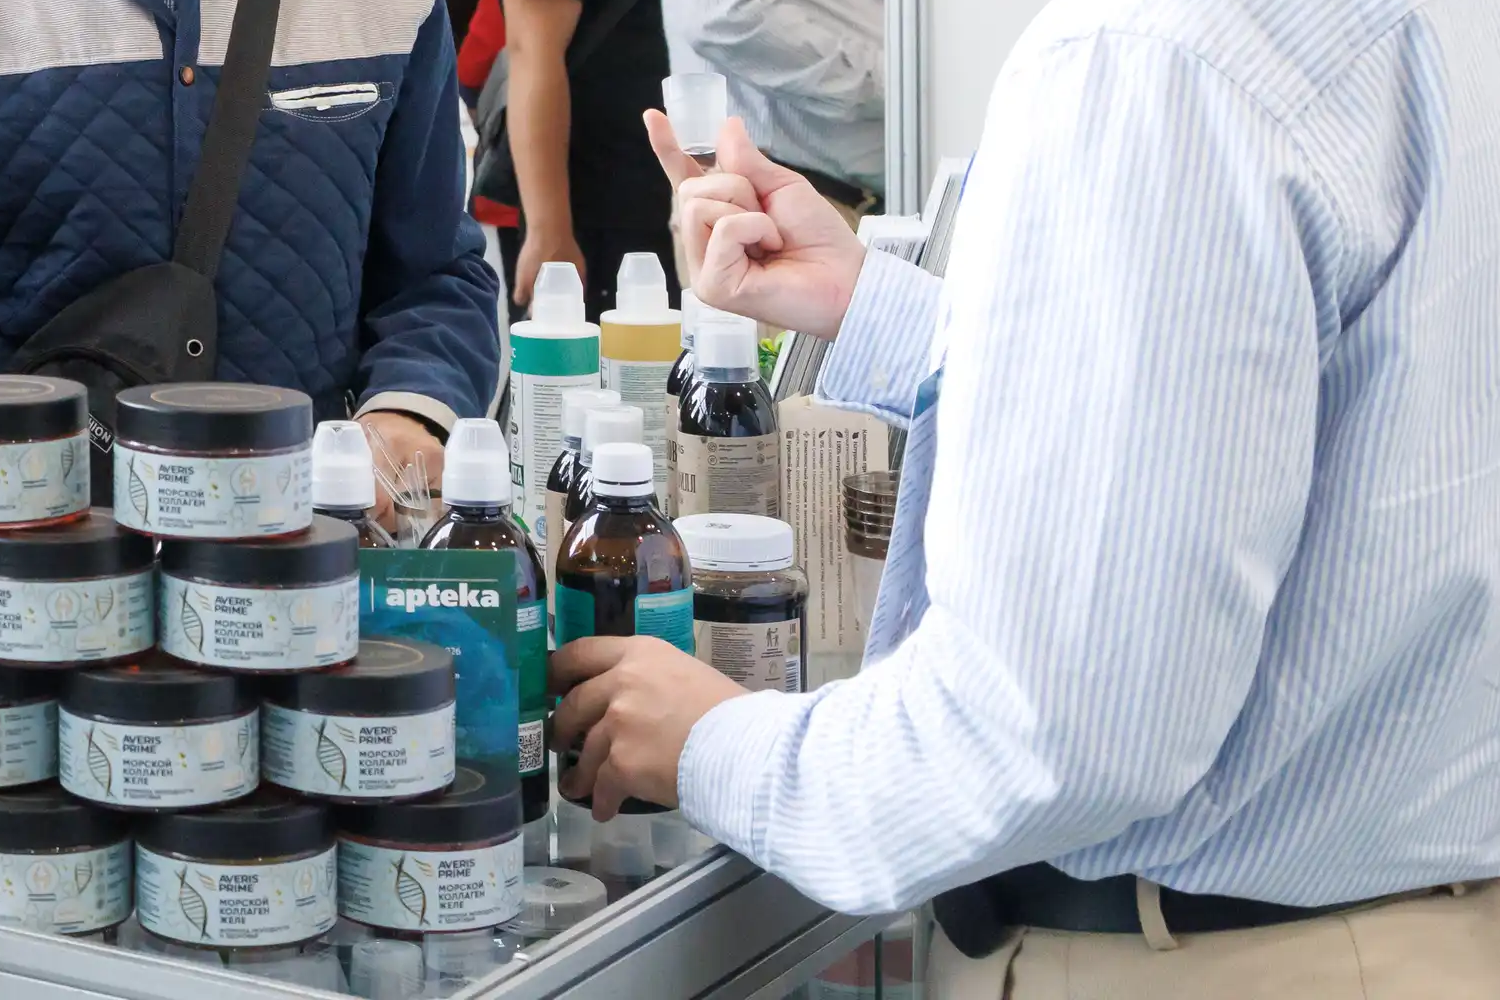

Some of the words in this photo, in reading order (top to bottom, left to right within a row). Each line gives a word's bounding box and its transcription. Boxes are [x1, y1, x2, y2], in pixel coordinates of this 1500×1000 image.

[158, 464, 194, 474] AVERIS
[158, 473, 190, 484] PRIME
[215, 595, 253, 607] AVERIS
[386, 582, 500, 613] apteka
[214, 605, 248, 616] PRIME
[359, 726, 397, 735] AVERIS
[123, 734, 162, 745] AVERIS
[358, 735, 393, 745] PRIME
[122, 744, 157, 754] PRIME
[359, 748, 407, 759] МОРСКОЙ
[123, 758, 172, 768] МОРСКОЙ
[359, 758, 407, 767] КОЛЛАГЕН
[123, 768, 173, 777] КОЛЛАГЕН
[359, 767, 385, 776] ЖЕЛЕ
[123, 777, 149, 785] ЖЕЛЕ
[438, 858, 476, 869] AVERIS
[438, 867, 472, 879] PRIME
[219, 874, 259, 884] AVERIS
[218, 883, 254, 893] PRIME
[438, 880, 484, 893] МОРСКОЙ
[438, 891, 486, 901] КОЛЛАГЕН
[219, 896, 269, 907] МОРСКОЙ
[219, 906, 270, 915] КОЛЛАГЕН
[220, 916, 246, 925] ЖЕЛЕ
